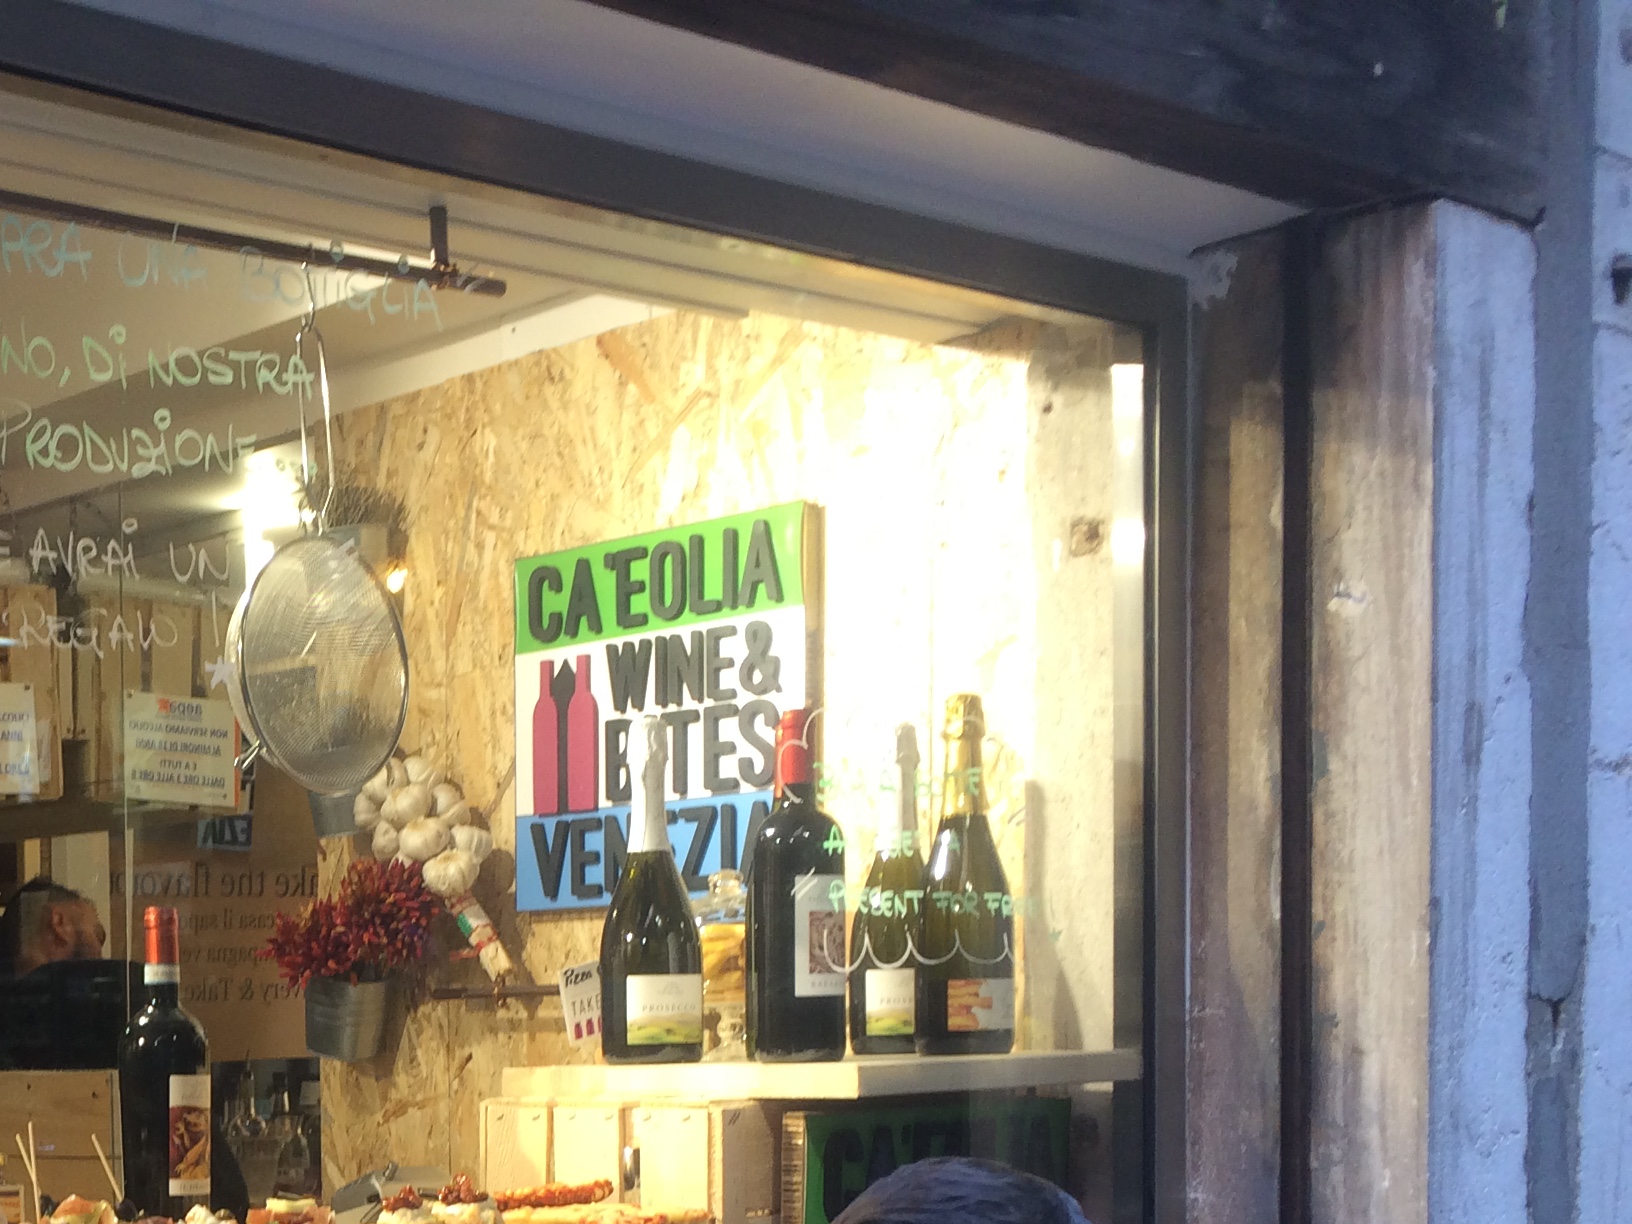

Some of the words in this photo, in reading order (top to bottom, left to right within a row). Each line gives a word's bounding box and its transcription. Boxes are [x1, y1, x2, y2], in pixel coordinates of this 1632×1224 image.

[148, 346, 315, 401] NOSTRA
[169, 540, 229, 583] UN
[527, 519, 786, 643] CA'EOLIA
[606, 620, 784, 713] WINE&
[605, 699, 781, 801] BTES
